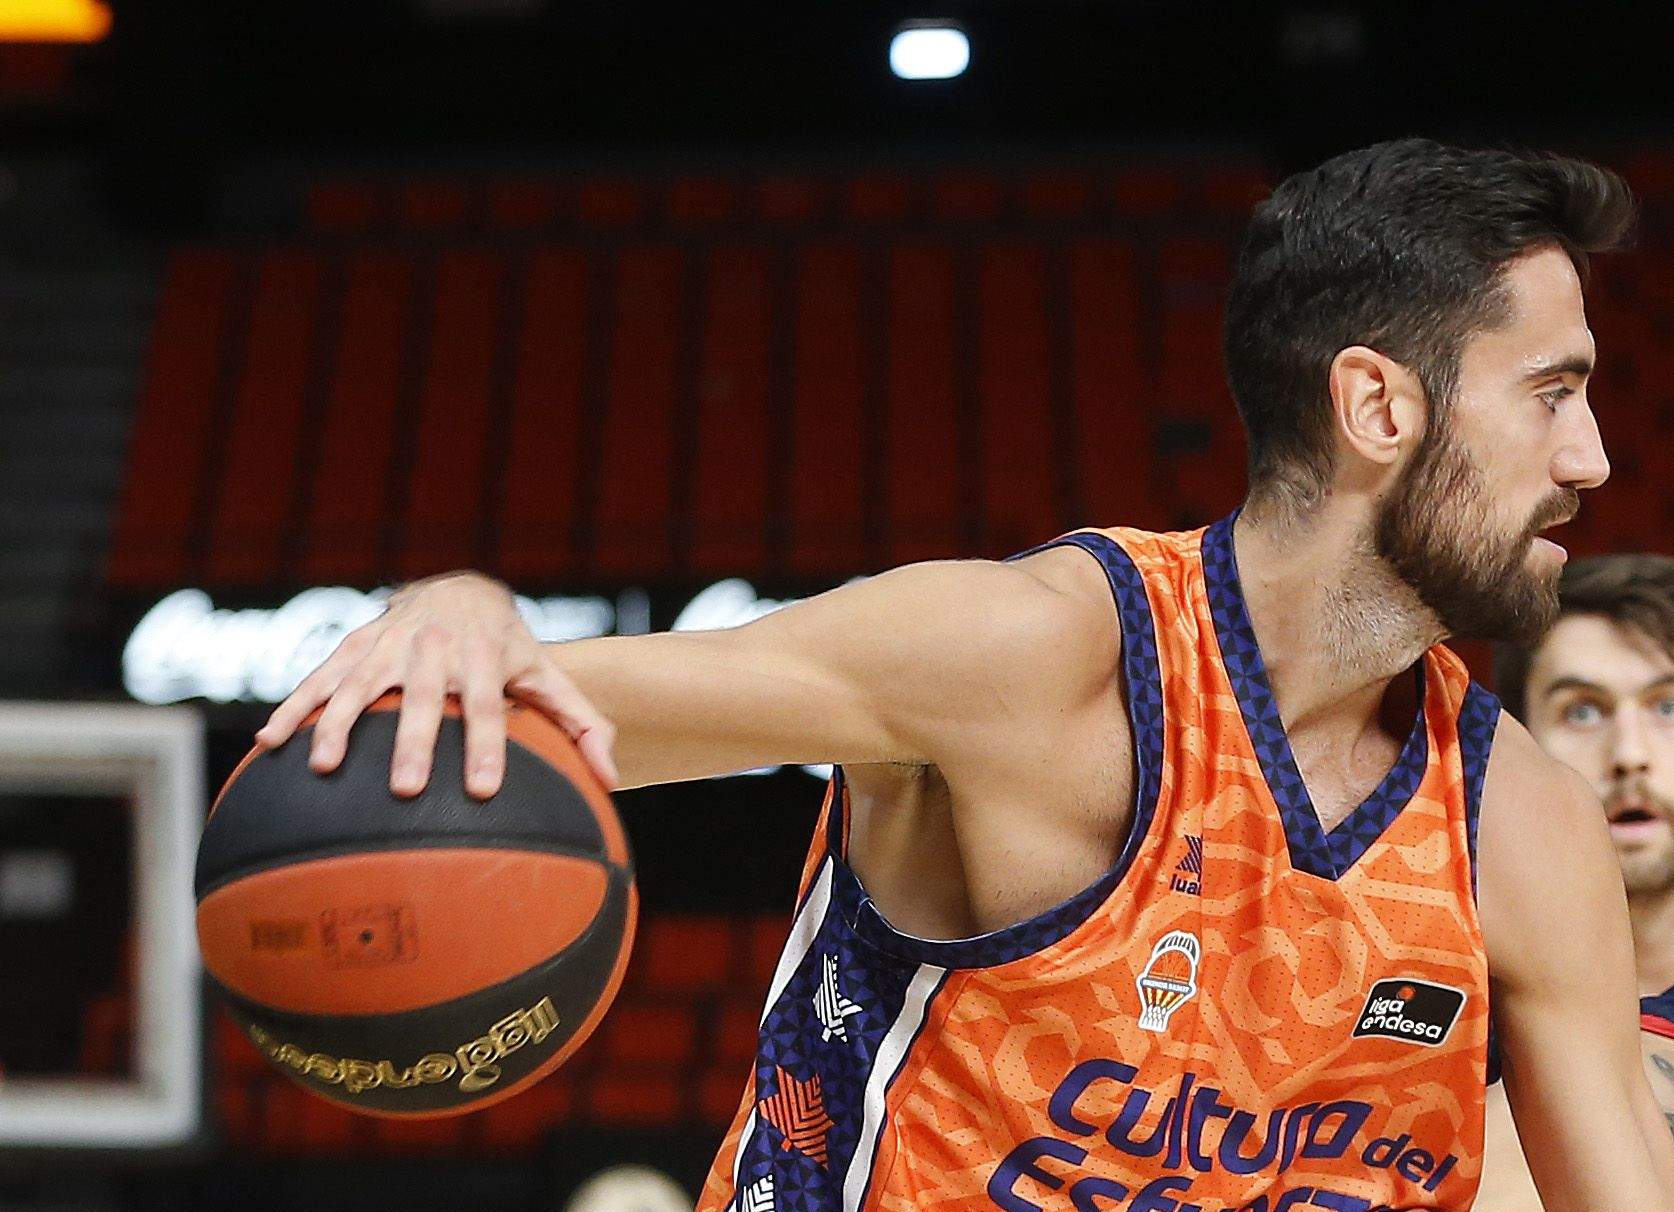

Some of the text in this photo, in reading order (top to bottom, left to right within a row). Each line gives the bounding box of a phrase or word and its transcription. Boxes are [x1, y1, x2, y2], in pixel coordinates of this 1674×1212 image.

[1170, 873, 1203, 897] lua
[1368, 996, 1405, 1015] liga
[1361, 1013, 1443, 1039] endesa
[1047, 1057, 1459, 1194] Cultura del
